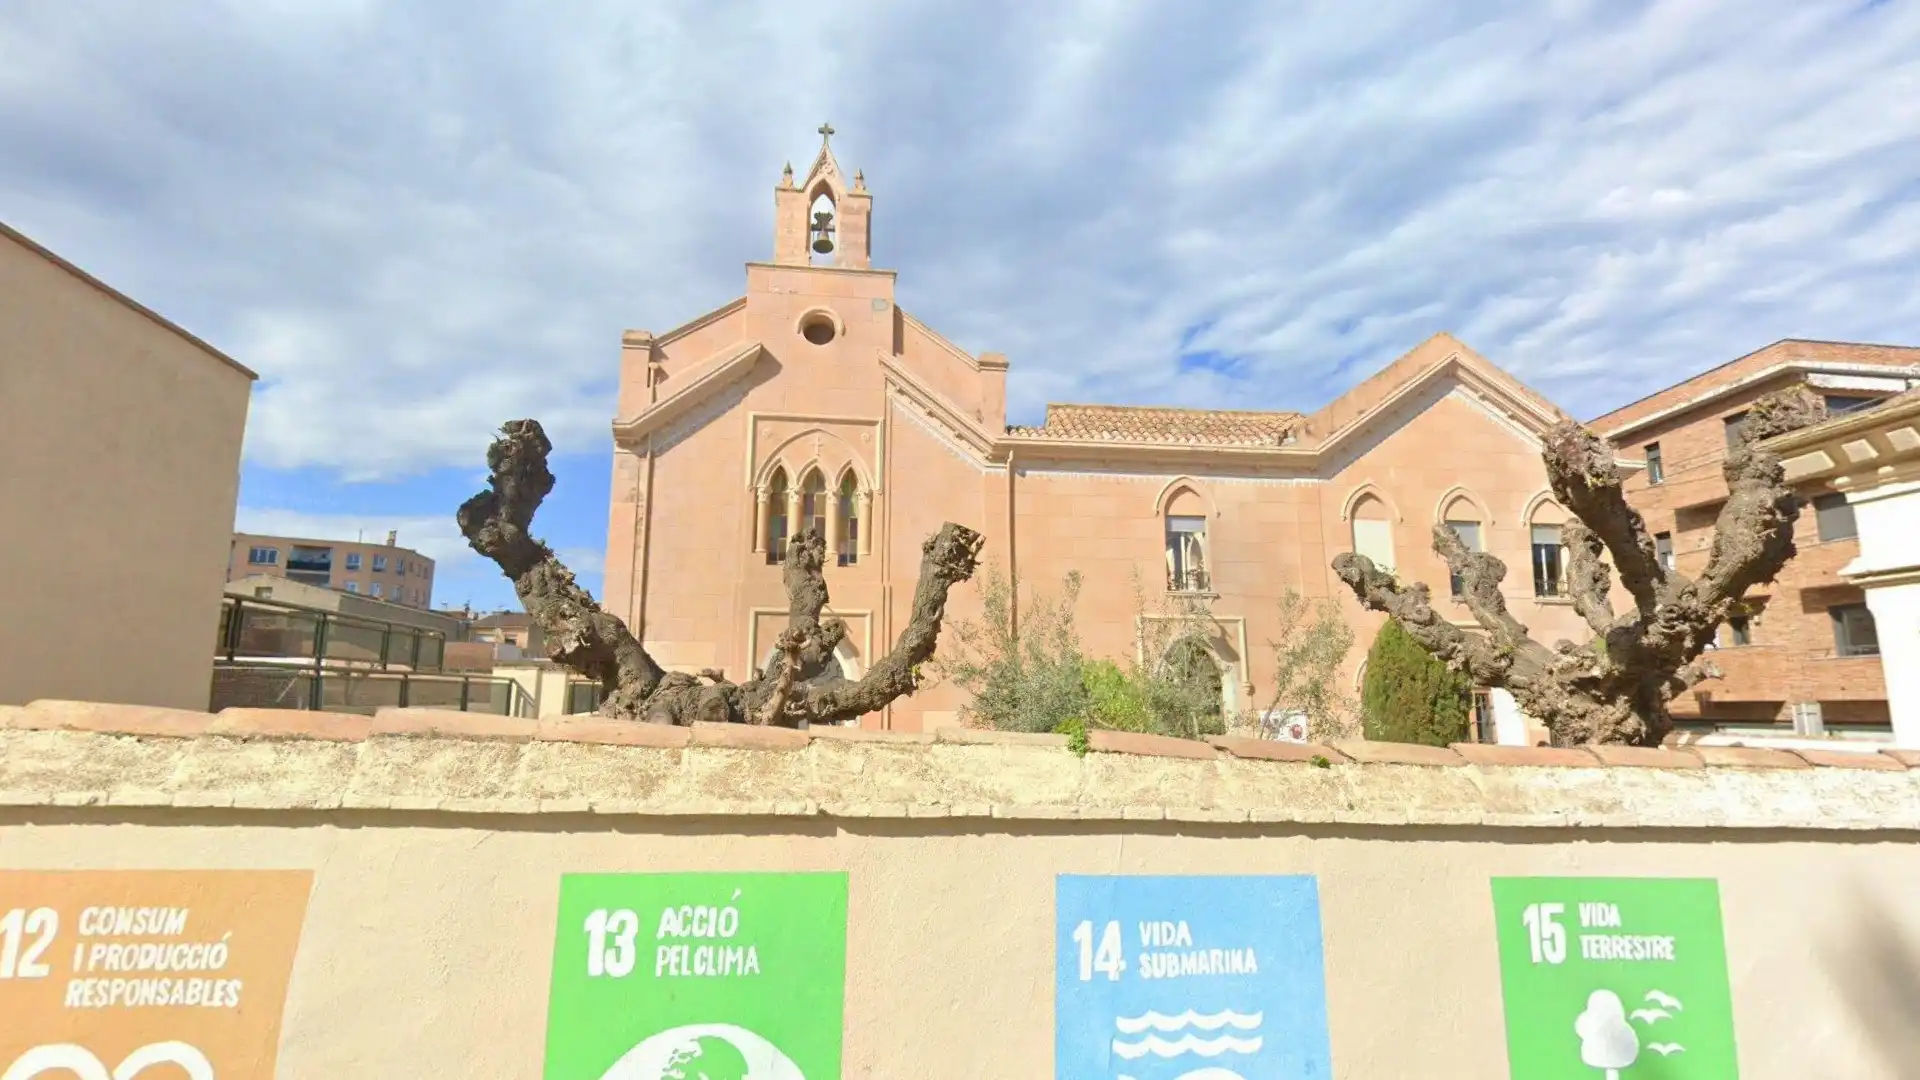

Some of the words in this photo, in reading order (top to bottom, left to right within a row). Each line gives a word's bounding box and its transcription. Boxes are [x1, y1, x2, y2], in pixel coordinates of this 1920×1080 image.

[78, 907, 189, 936] CONSUM
[656, 888, 741, 939] ACCIÓ
[1578, 903, 1621, 927] VIDA
[0, 907, 58, 978] 12
[73, 943, 83, 972] I
[88, 931, 233, 971] PRODUCCIÓ
[584, 909, 639, 977] 13
[1073, 920, 1126, 981] 14
[1138, 920, 1192, 947] VIDA
[1523, 903, 1566, 964] 15
[1578, 935, 1675, 961] TERRESTRE
[1138, 948, 1258, 979] SUBMARINA
[64, 979, 243, 1008] RESPONSABLES
